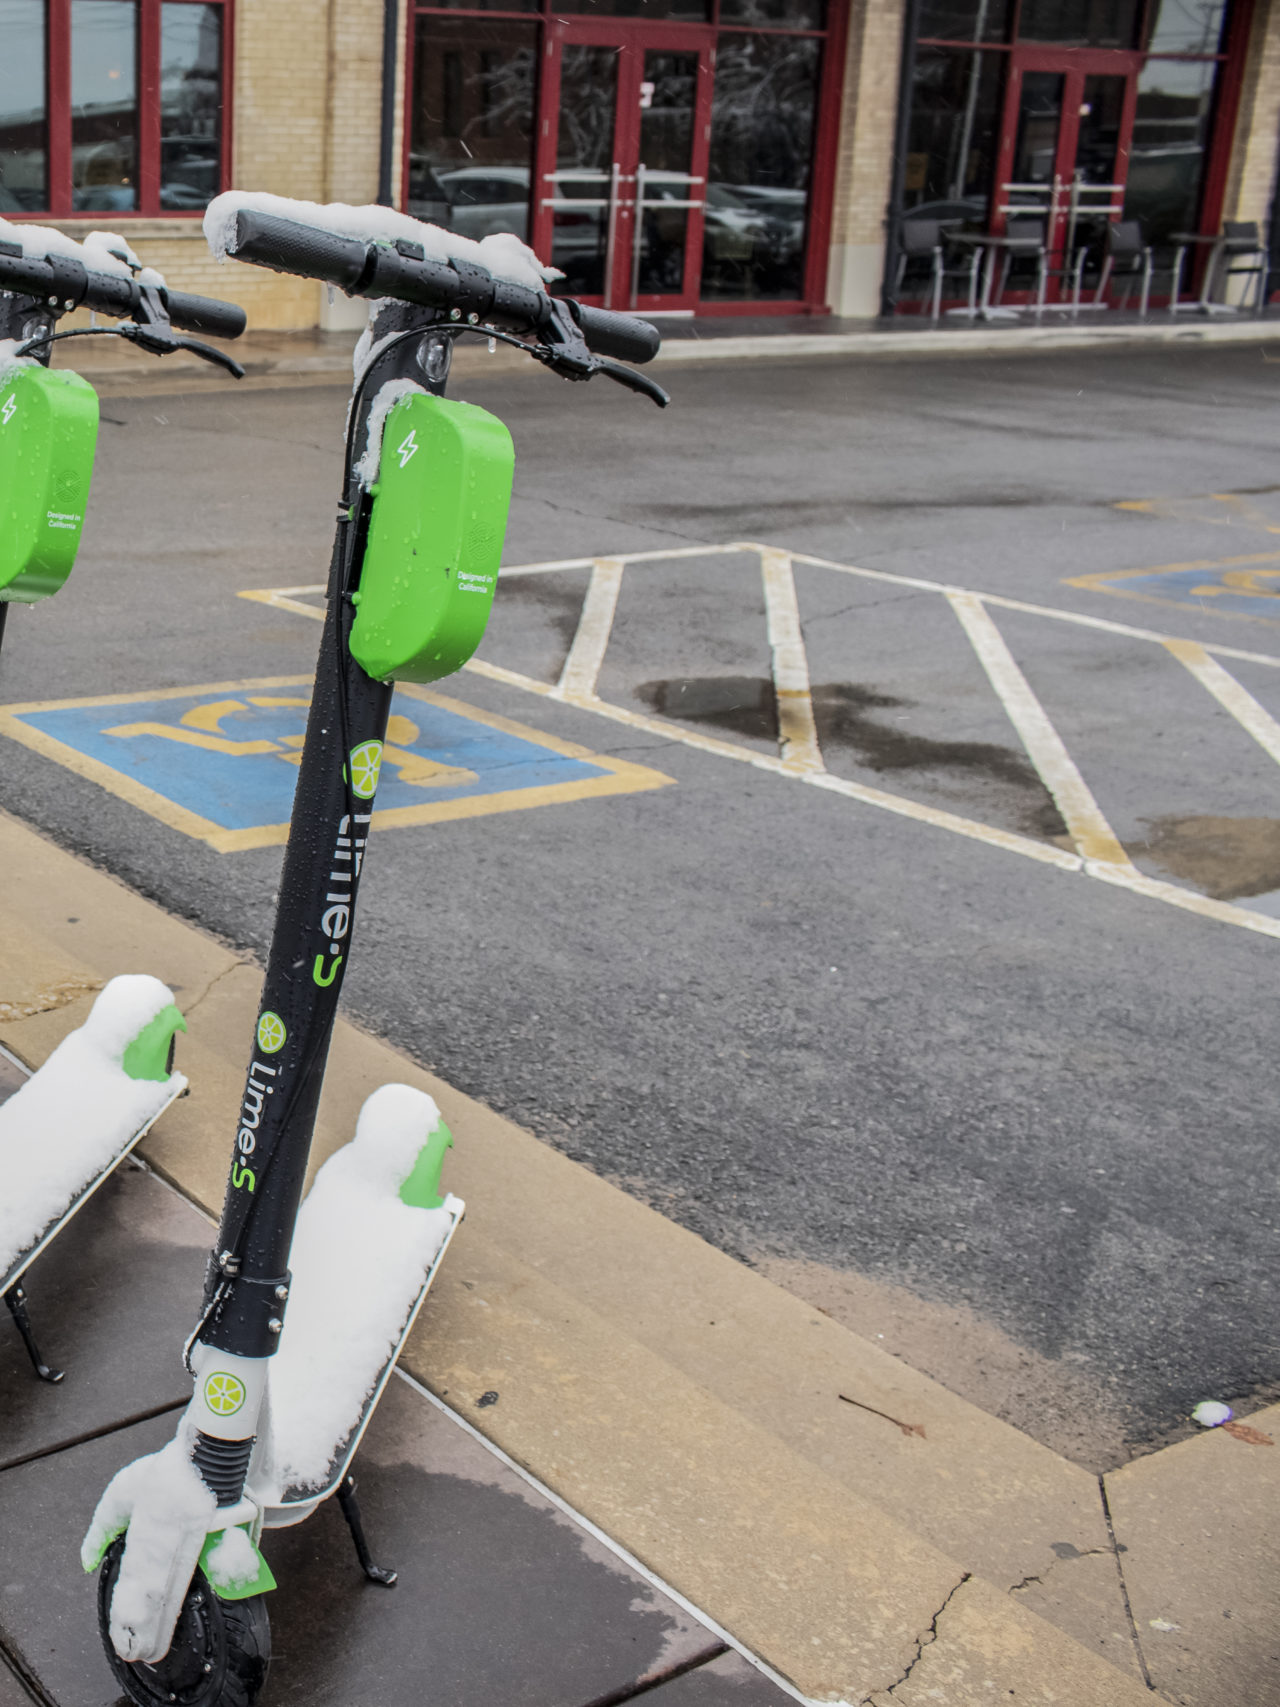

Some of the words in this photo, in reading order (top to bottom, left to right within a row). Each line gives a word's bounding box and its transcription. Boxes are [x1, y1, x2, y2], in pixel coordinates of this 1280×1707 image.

[47, 510, 75, 520] Designed
[48, 519, 77, 530] California
[457, 571, 486, 582] Designed
[458, 582, 488, 593] California
